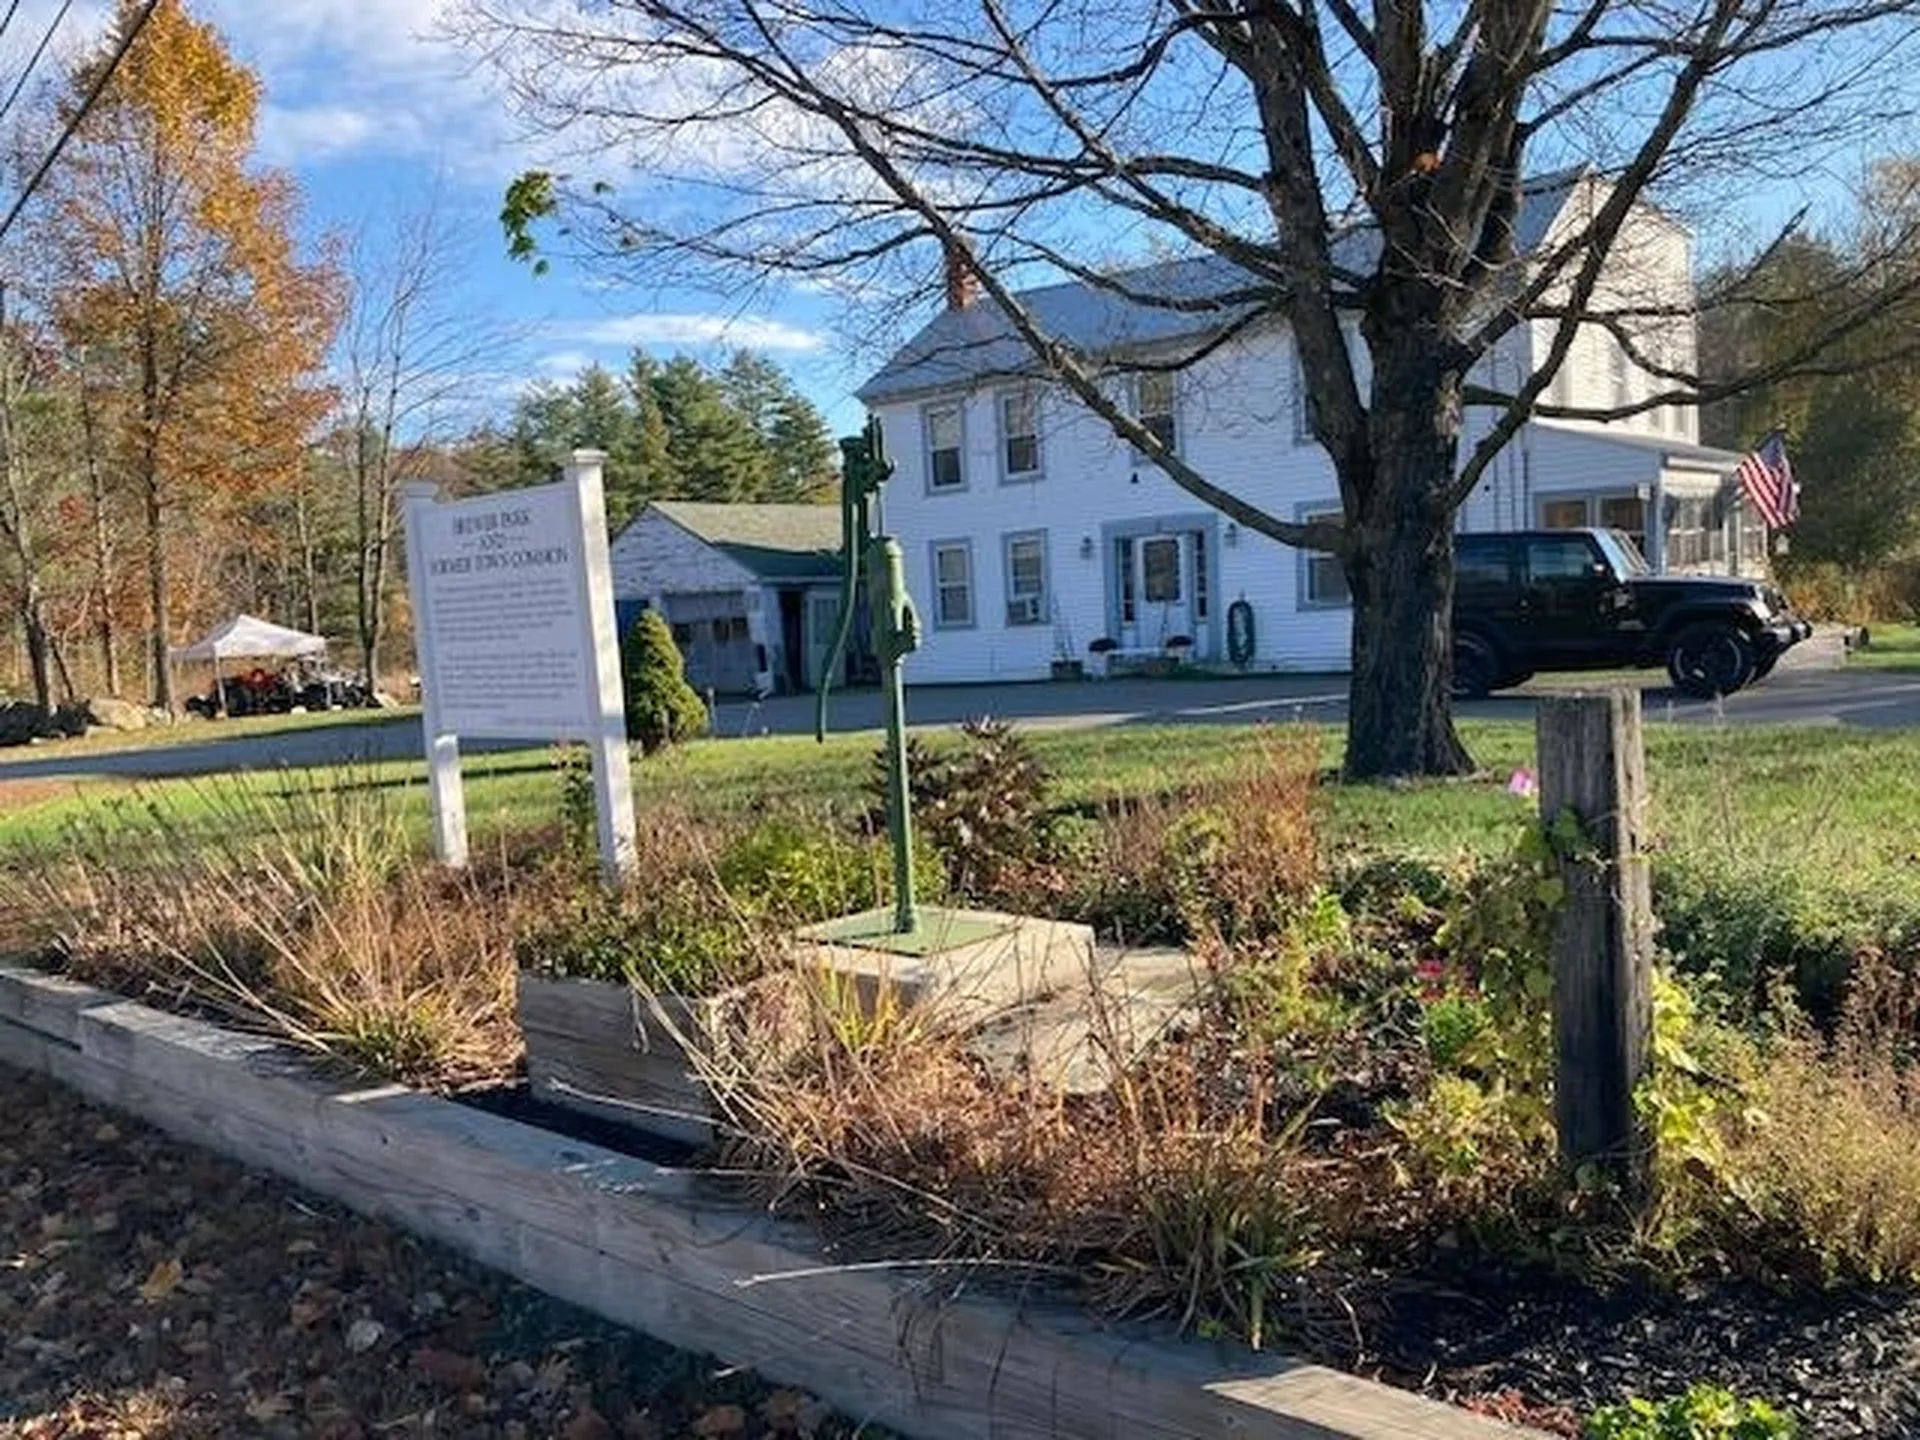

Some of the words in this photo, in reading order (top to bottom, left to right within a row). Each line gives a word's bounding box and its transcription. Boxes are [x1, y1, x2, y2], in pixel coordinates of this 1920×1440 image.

[479, 532, 508, 550] AND
[474, 551, 509, 571] TOWN
[510, 547, 570, 569] COMMON
